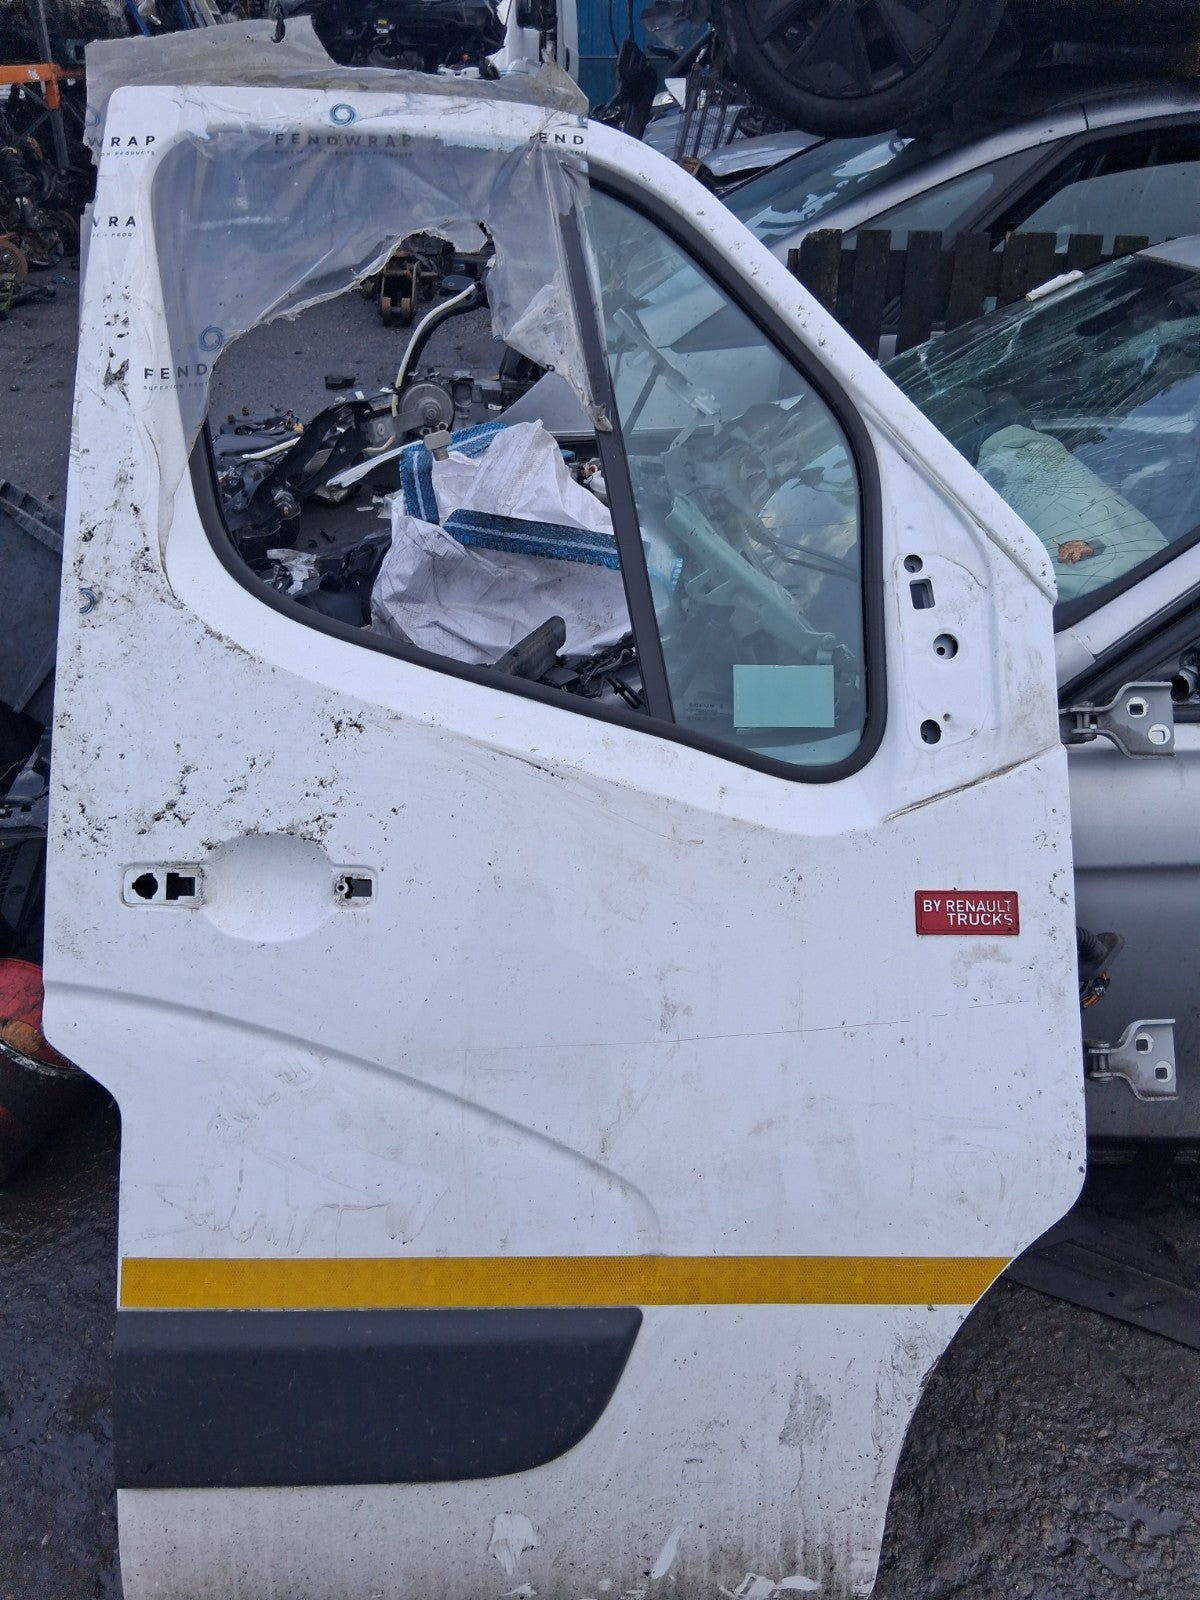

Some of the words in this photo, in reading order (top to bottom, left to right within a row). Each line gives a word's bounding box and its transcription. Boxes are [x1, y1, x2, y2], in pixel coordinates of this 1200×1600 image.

[144, 363, 208, 380] FEND
[923, 899, 941, 912] BY
[946, 899, 1012, 913] RENAULT
[946, 913, 1013, 926] TRUCKS
